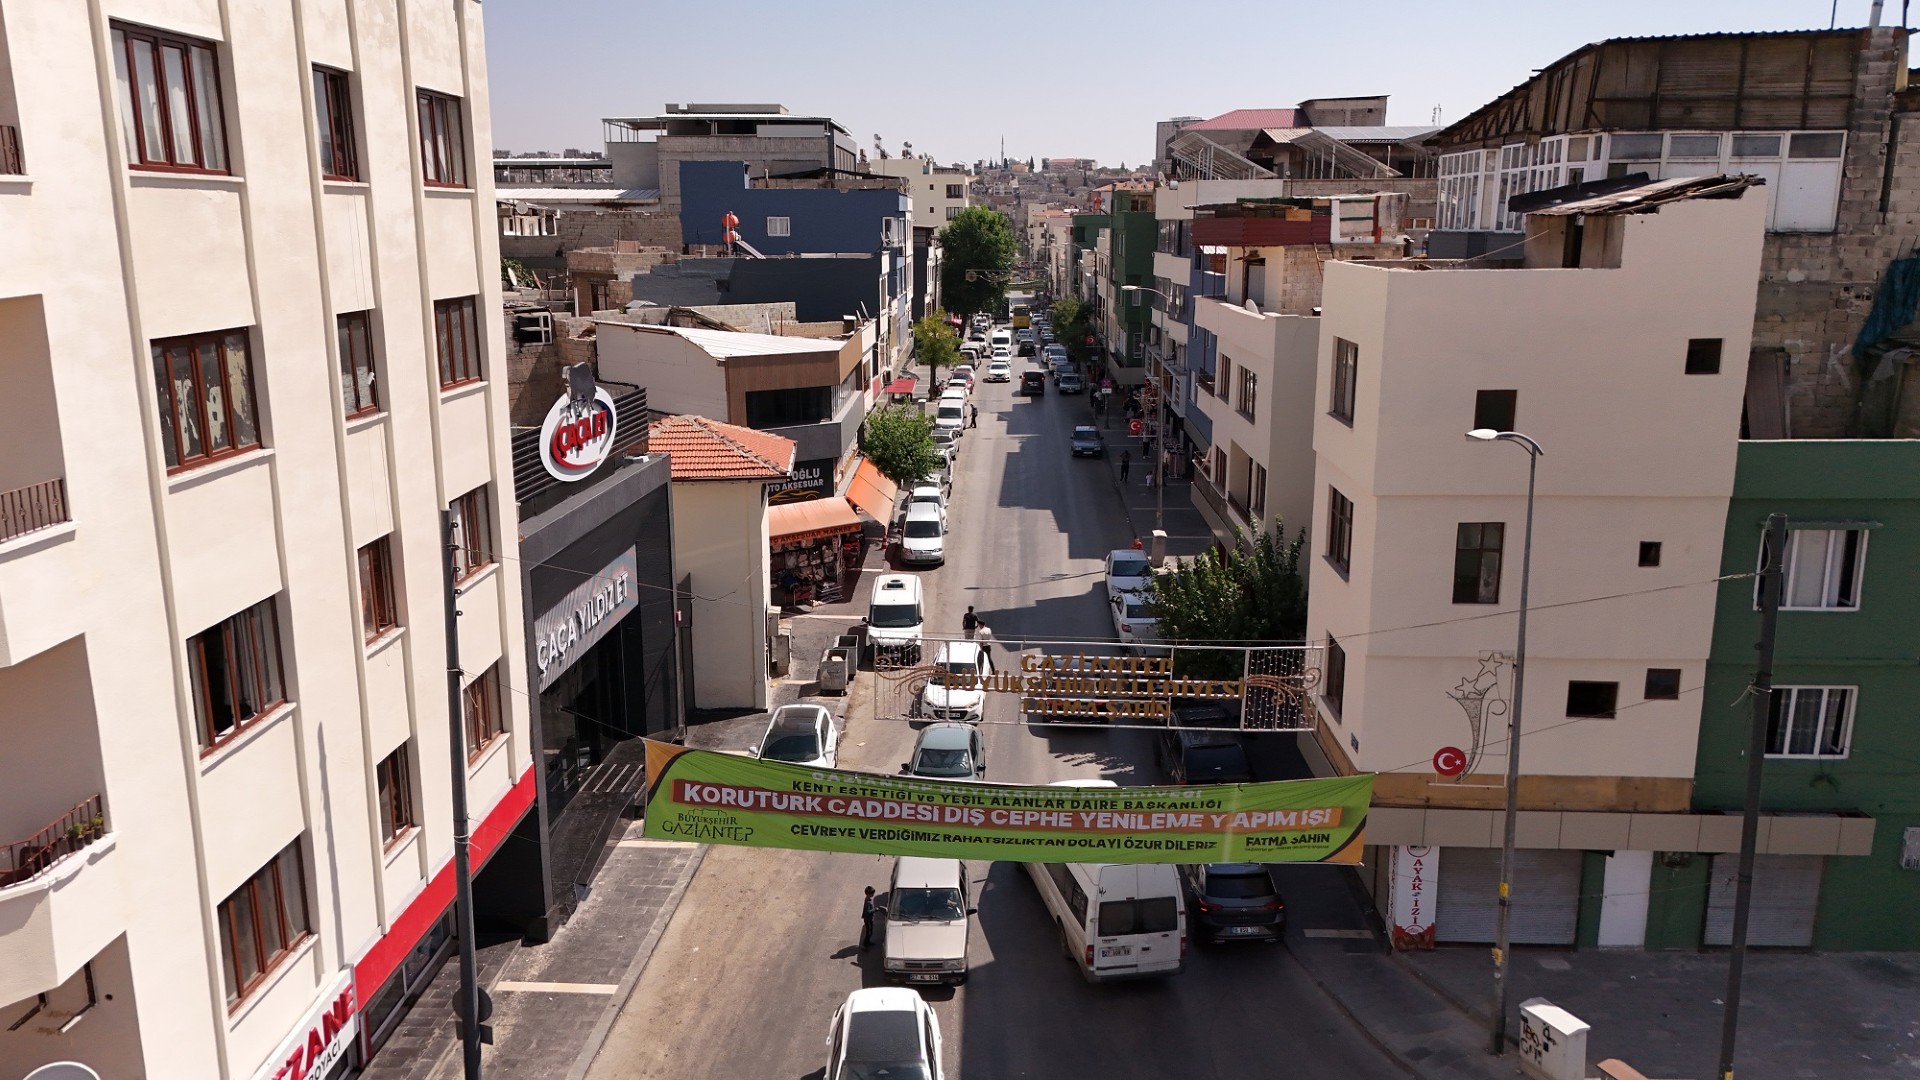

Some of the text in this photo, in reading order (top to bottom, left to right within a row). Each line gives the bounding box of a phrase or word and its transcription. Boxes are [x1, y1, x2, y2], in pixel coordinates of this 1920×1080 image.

[558, 410, 607, 459] ÇAÇA ET
[782, 478, 824, 491] AKSESUAR
[787, 467, 820, 481] OĞLU
[781, 531, 822, 543] AKSESUAR
[537, 570, 629, 677] ÇAÇA YILDIZ ET
[684, 783, 823, 812] KORUTÜRK
[827, 798, 939, 822] CADDESİ
[944, 807, 985, 826] DIŞ
[990, 809, 1073, 827] CEPHE
[1080, 811, 1204, 830] YENİLEME
[1300, 808, 1333, 827] İŞİ
[792, 780, 1222, 810] KENT ESTETİĞİ ve YEŞİL ALANLAR DAİRE BAŞKANLIĞI
[662, 820, 754, 842] GAZİANTEP
[790, 824, 856, 838] ÇEVREYE
[943, 833, 1065, 847] RAHATSIZLIKTAN
[1068, 838, 1121, 849] DOLAYI
[1124, 836, 1162, 850] ÖZÜR
[1245, 835, 1288, 848] FATMA
[1411, 858, 1424, 891] AYAK
[1410, 897, 1421, 924] İZİ
[271, 983, 355, 1080] ZANE
